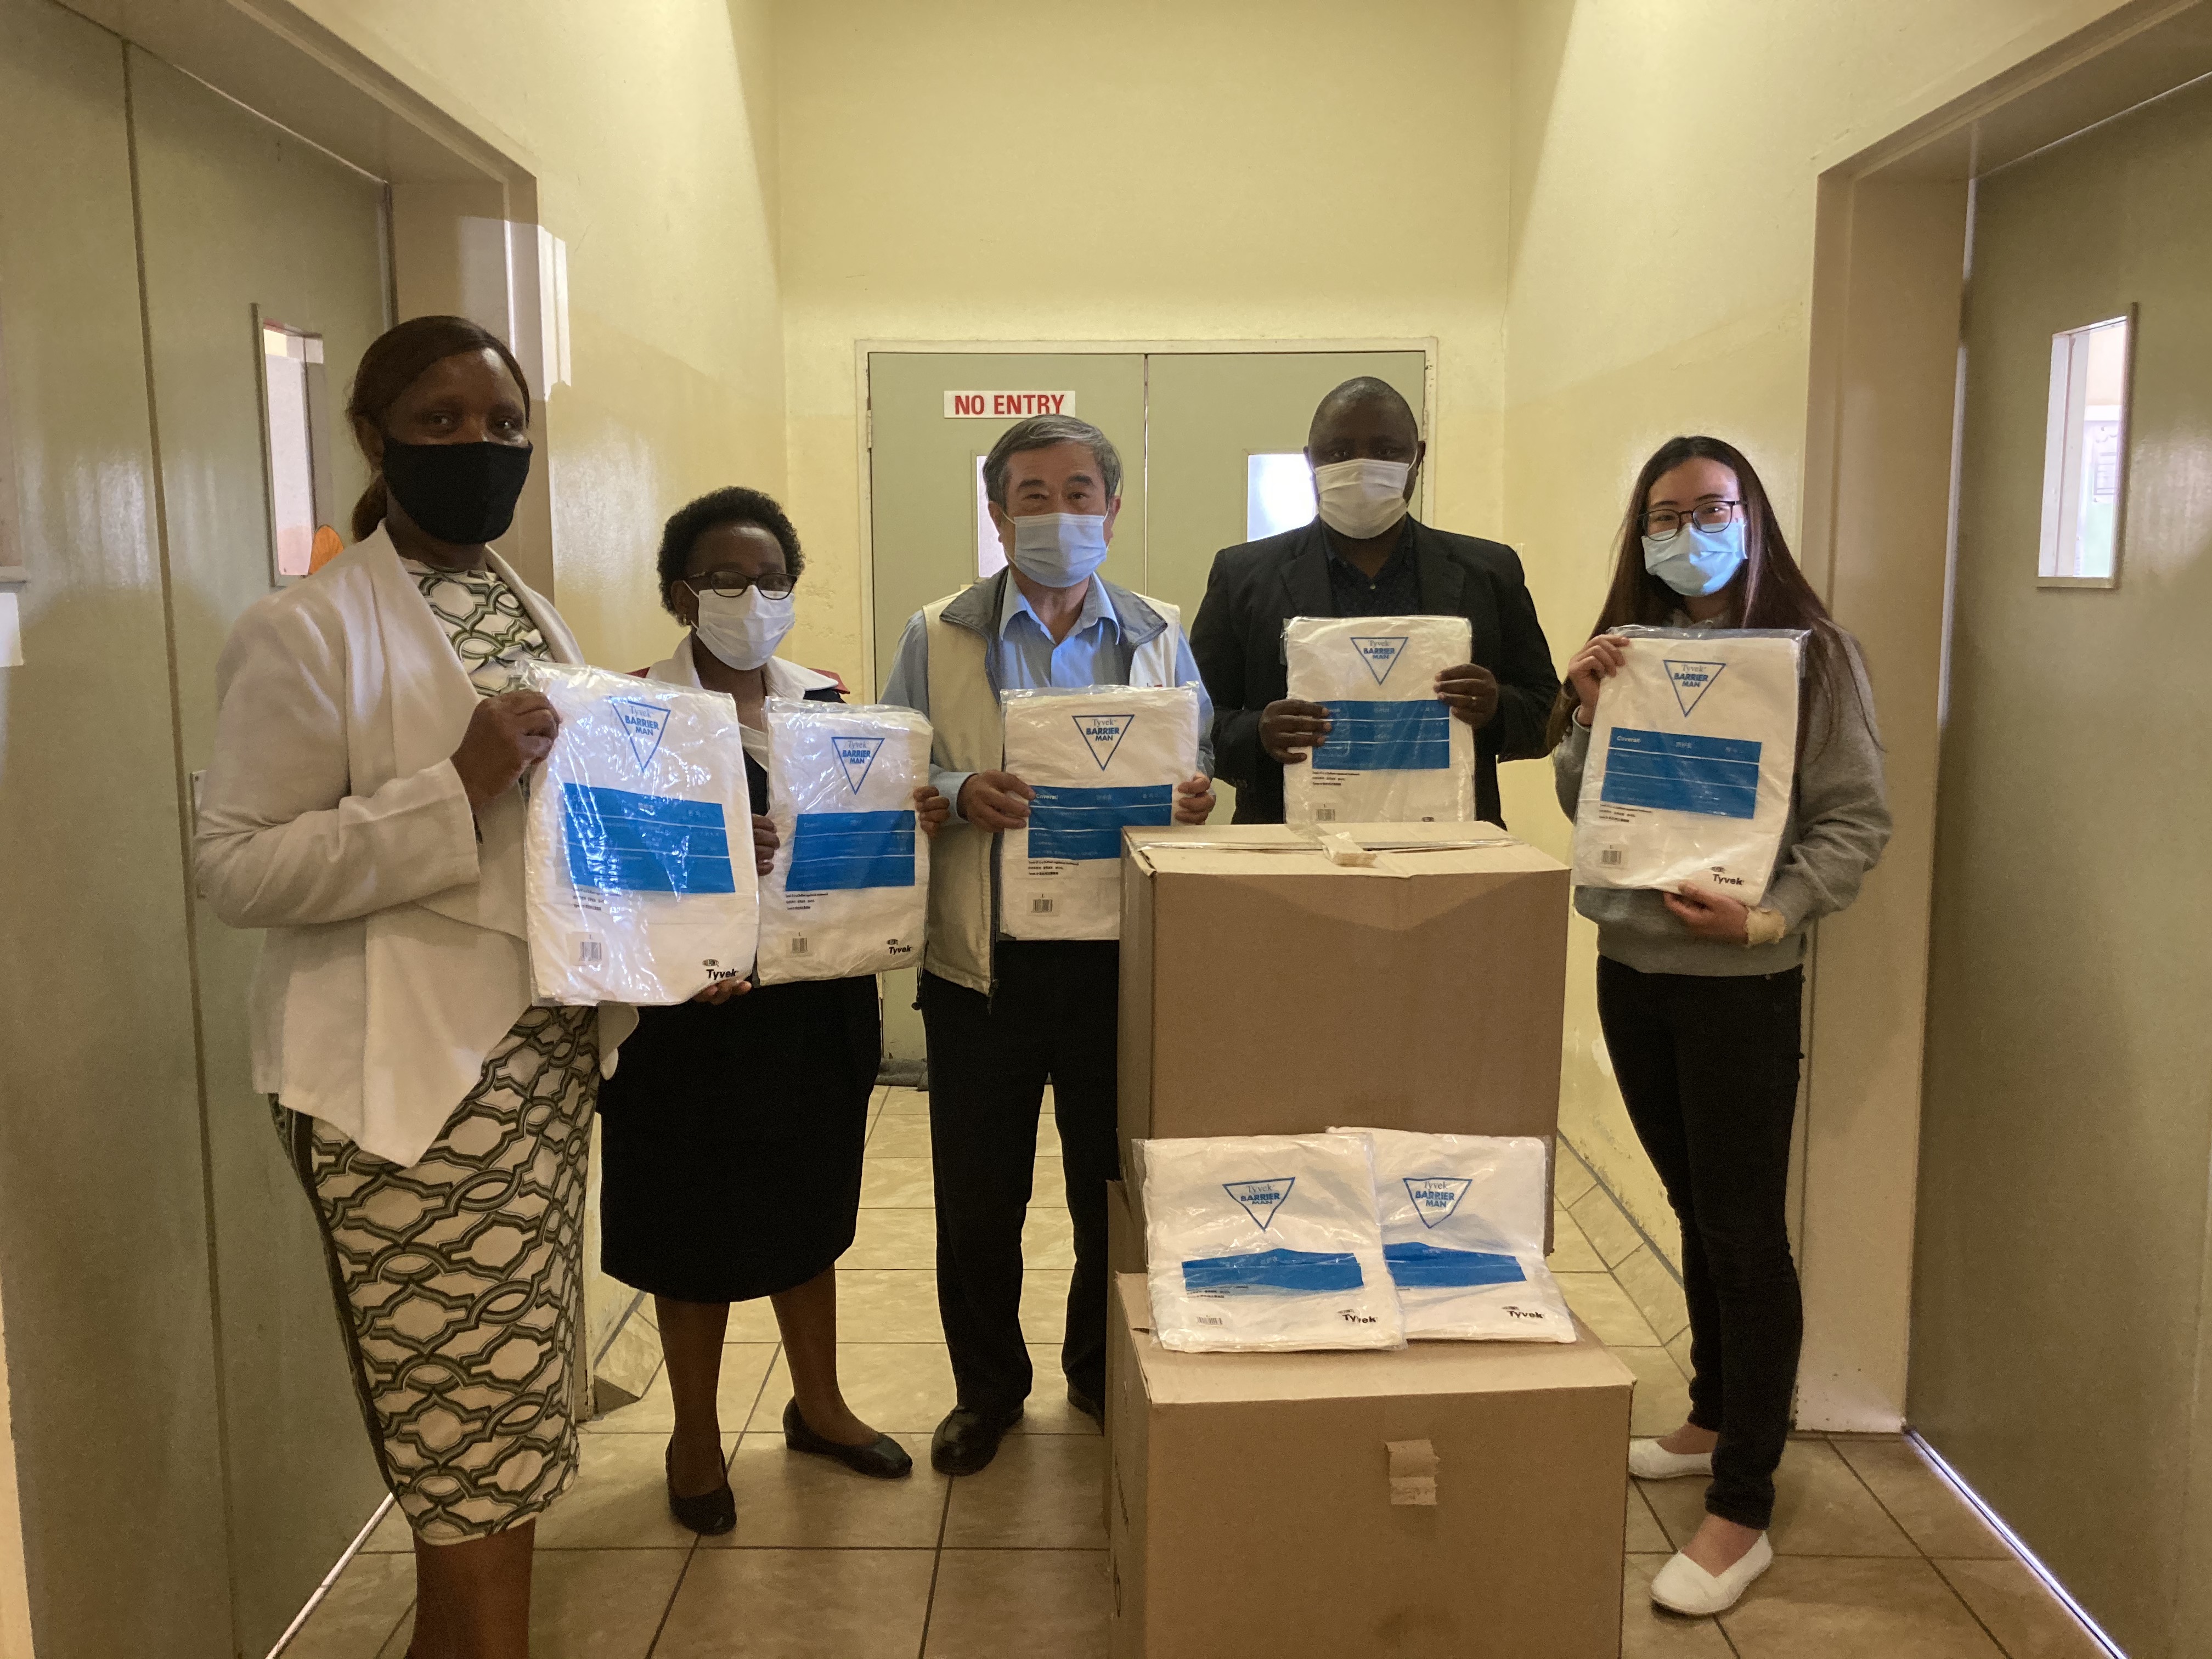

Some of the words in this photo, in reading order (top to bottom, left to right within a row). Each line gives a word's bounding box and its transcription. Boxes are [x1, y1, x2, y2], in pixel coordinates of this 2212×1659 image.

[955, 395, 985, 415] NO
[994, 394, 1065, 415] ENTRY
[1682, 664, 1703, 673] Tyvek
[1674, 673, 1708, 681] BARRIER
[629, 706, 651, 718] Tyvek
[625, 715, 659, 730] BARRIER
[1092, 718, 1114, 727] Tyvek
[635, 726, 653, 736] MAN
[848, 741, 866, 749] Tyvek
[1712, 874, 1742, 885] Tyvek
[889, 945, 911, 955] Tyvek
[706, 968, 737, 980] Tyvek
[1246, 1184, 1272, 1194] Tyvek
[1424, 1181, 1447, 1190] Tyvek
[1240, 1193, 1280, 1201] BARRIER
[1415, 1190, 1454, 1200] BARRIER
[1342, 1314, 1376, 1323] Tyvek
[1507, 1310, 1543, 1318] Tyvek
